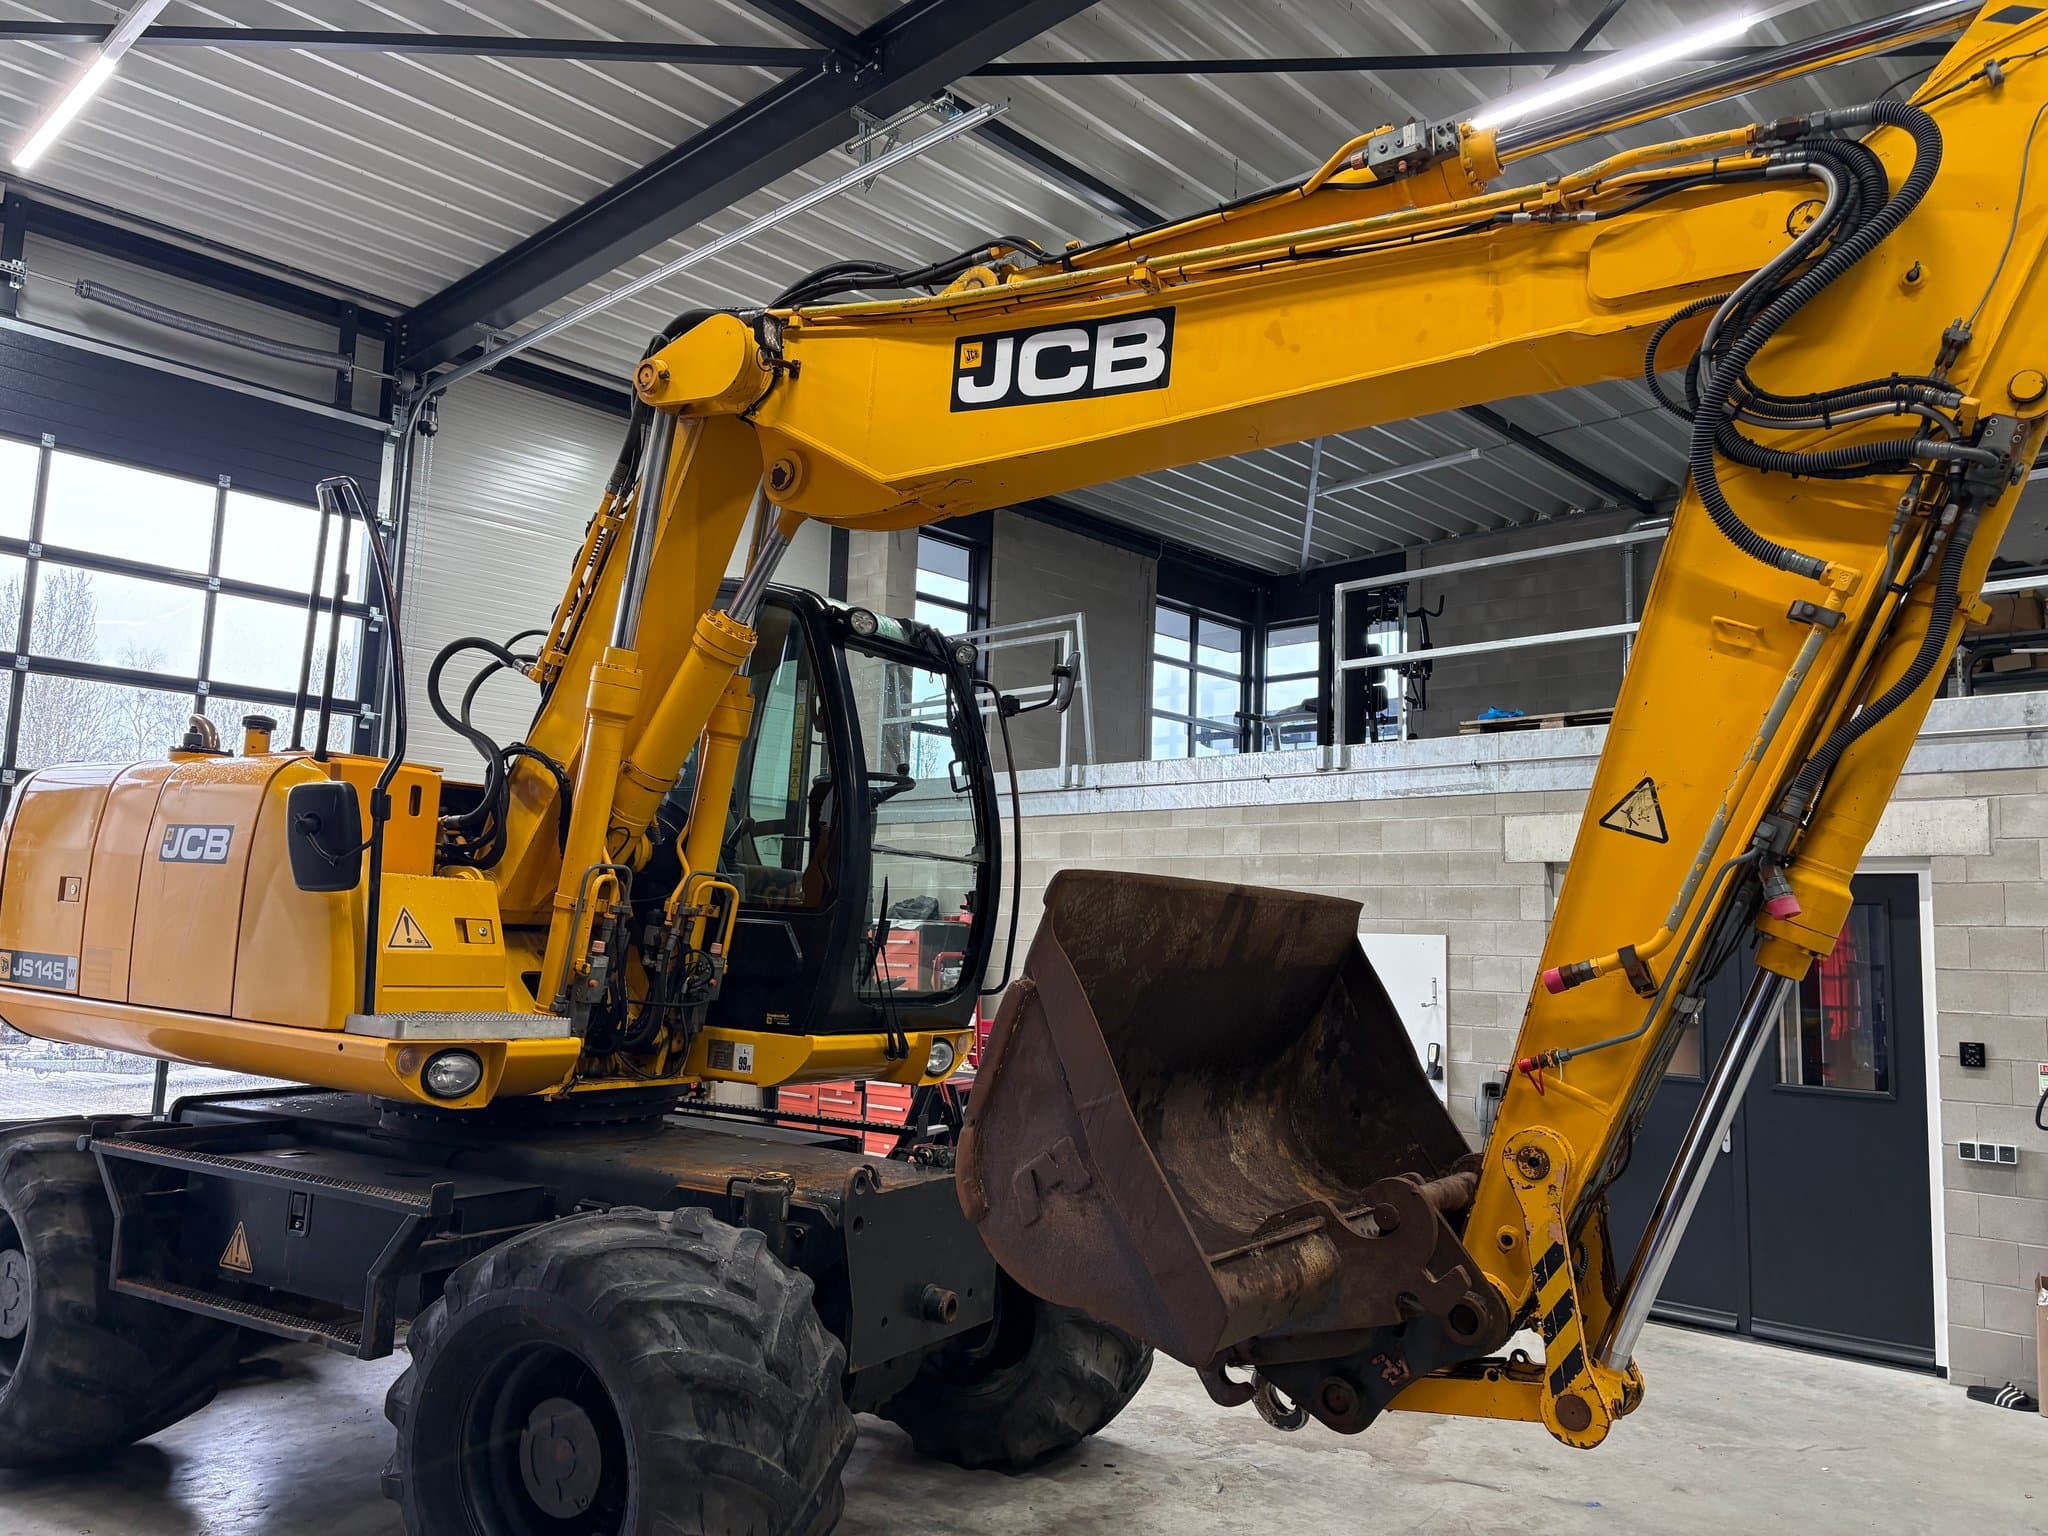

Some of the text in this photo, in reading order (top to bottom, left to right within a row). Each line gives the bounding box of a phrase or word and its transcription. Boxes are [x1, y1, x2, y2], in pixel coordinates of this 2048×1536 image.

[957, 316, 1167, 404] JCB
[162, 827, 231, 860] JCB
[13, 958, 65, 981] JS145
[67, 967, 76, 978] W
